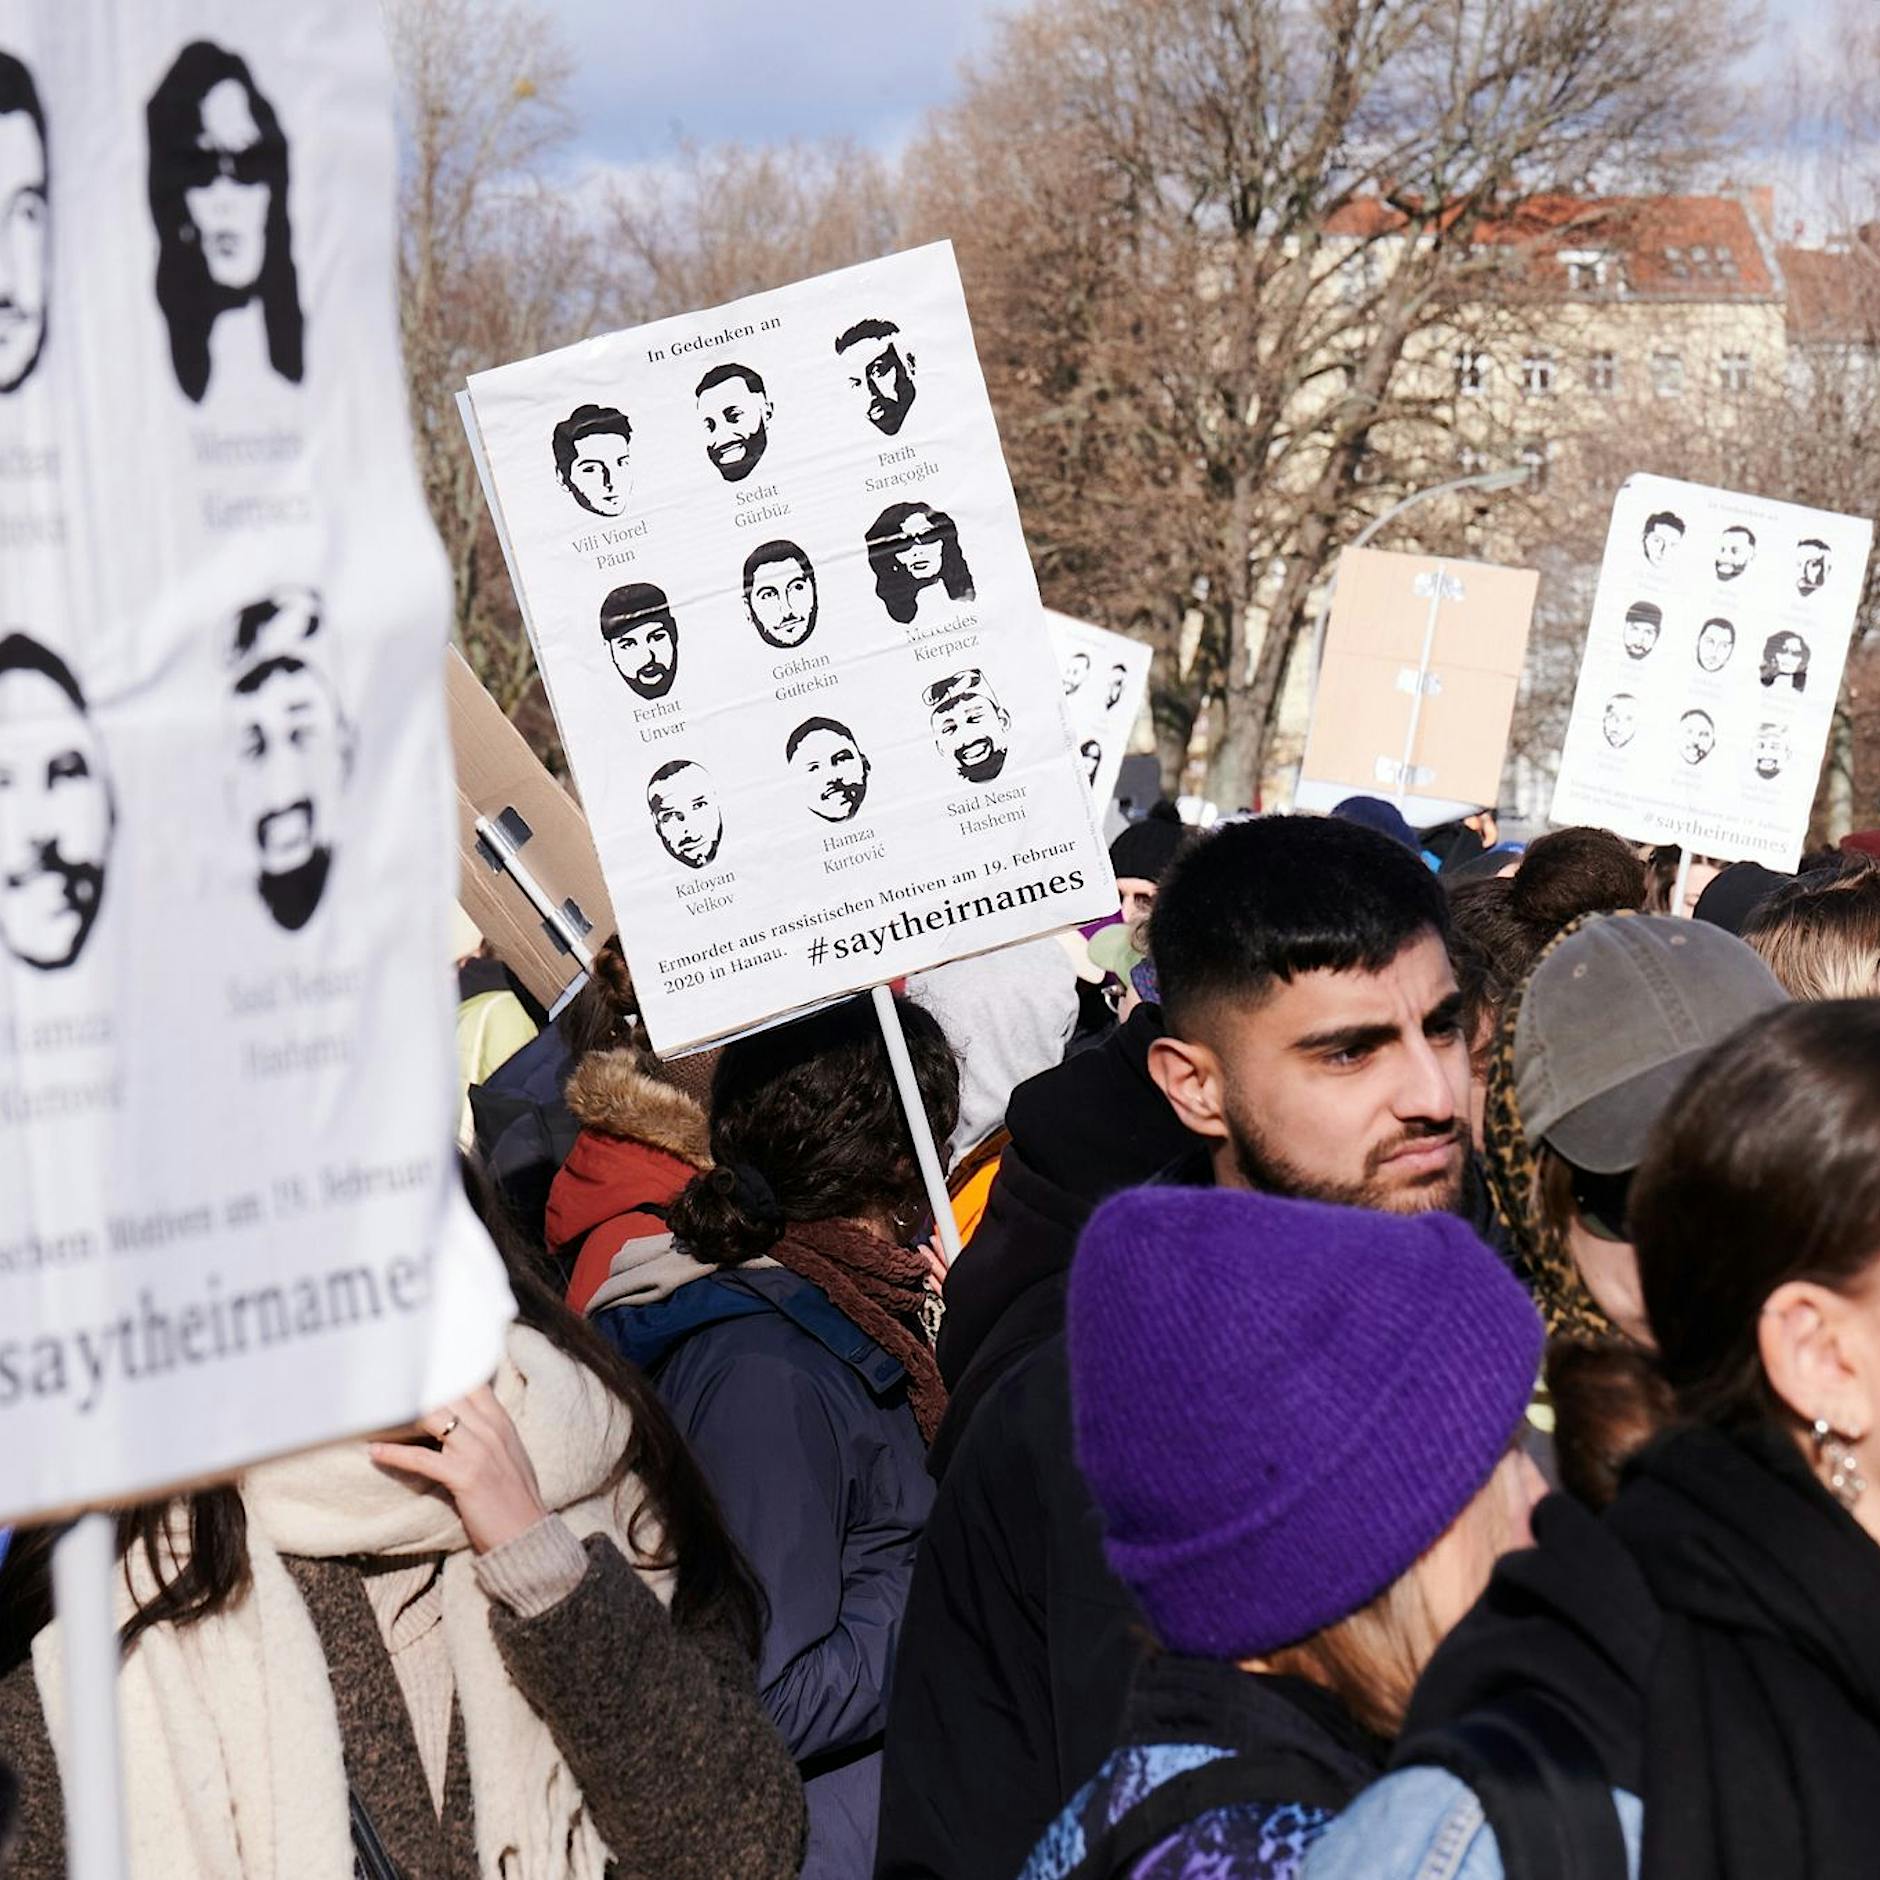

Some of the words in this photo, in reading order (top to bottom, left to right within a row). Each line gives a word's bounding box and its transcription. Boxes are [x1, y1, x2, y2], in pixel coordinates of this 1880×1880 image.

[647, 350, 665, 362] In
[670, 325, 754, 357] Gedenken
[760, 317, 781, 331] an
[877, 445, 916, 467] Fatih
[864, 460, 940, 492] Saraçoğlu
[735, 483, 778, 506] Sedat
[734, 504, 792, 528] Gürbüz
[572, 534, 597, 554] Vili
[601, 520, 649, 547] Viorel
[596, 549, 636, 570] Păun
[913, 634, 979, 663] Kierpacz
[772, 654, 831, 680] Gökhan
[774, 671, 839, 701] Gültekin
[632, 700, 681, 723] Ferhat
[639, 719, 686, 743] Unvar
[946, 798, 981, 818] Said
[984, 784, 1027, 809] Nesar
[958, 805, 1027, 837] Hashemi
[821, 825, 875, 853] Hamza
[822, 843, 886, 875] Kurtović
[674, 871, 736, 898] Kaloyan
[657, 936, 734, 974] Ermordet
[738, 928, 767, 949] aus
[770, 895, 875, 939] rassistischen
[878, 875, 946, 905] Motiven
[951, 866, 977, 886] am
[983, 859, 1007, 877] 19.
[1011, 839, 1077, 867] Februar
[686, 892, 736, 917] Velkov
[806, 869, 1084, 967] #saytheirnames
[663, 971, 706, 994] 2020
[709, 964, 727, 981] in
[729, 949, 788, 974] Hanau.
